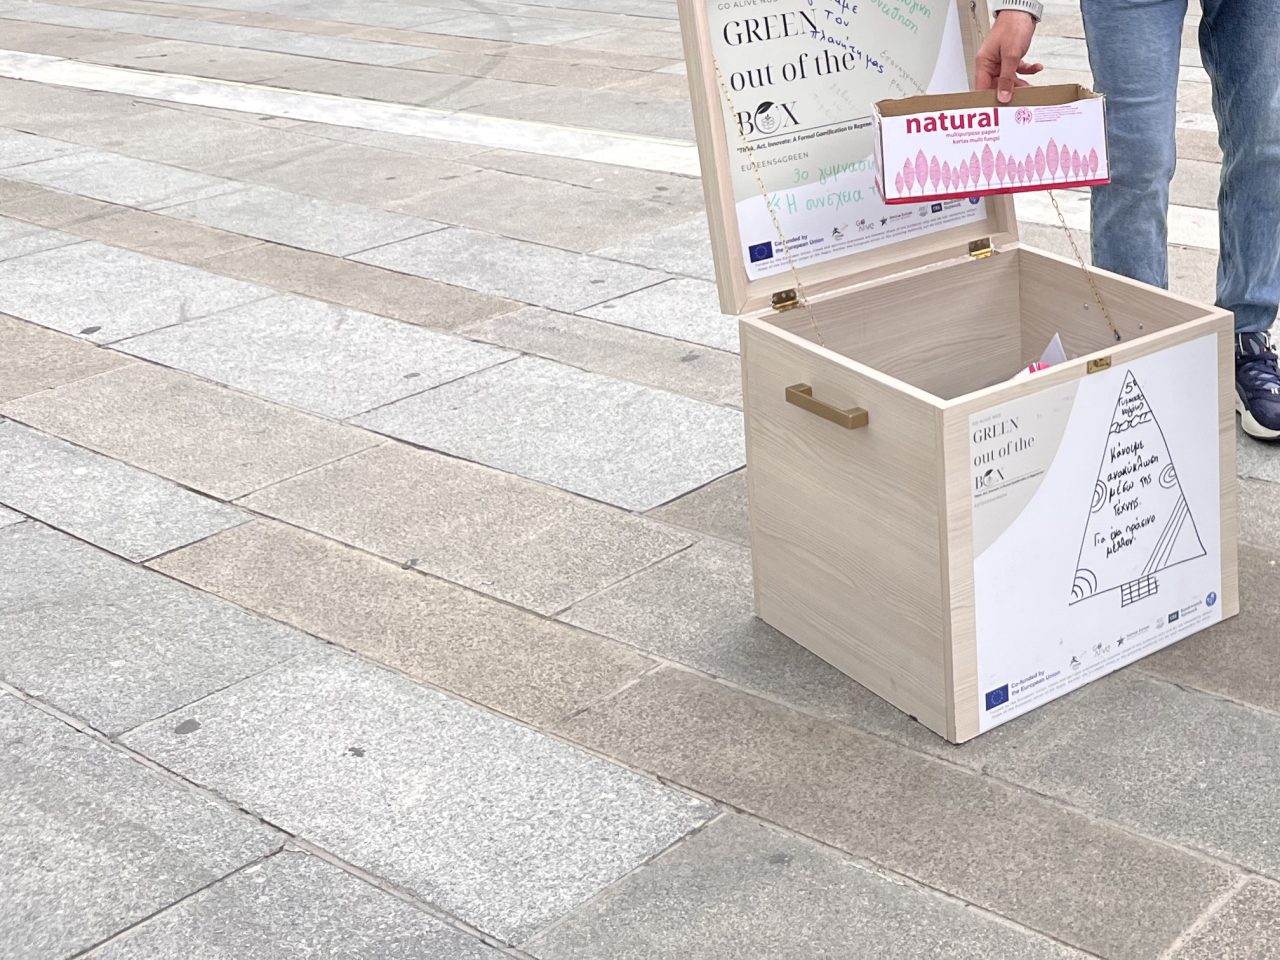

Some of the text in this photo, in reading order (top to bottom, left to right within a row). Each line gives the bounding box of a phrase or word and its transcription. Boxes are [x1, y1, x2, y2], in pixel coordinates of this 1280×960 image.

[718, 2, 730, 10] GO
[723, 8, 817, 47] GREEN
[730, 48, 856, 92] out of the
[736, 100, 801, 137] BOX
[906, 107, 999, 134] natural
[741, 151, 809, 173] EUEENS4GREEN
[973, 416, 1019, 444] GREEN
[974, 436, 1035, 467] out of the
